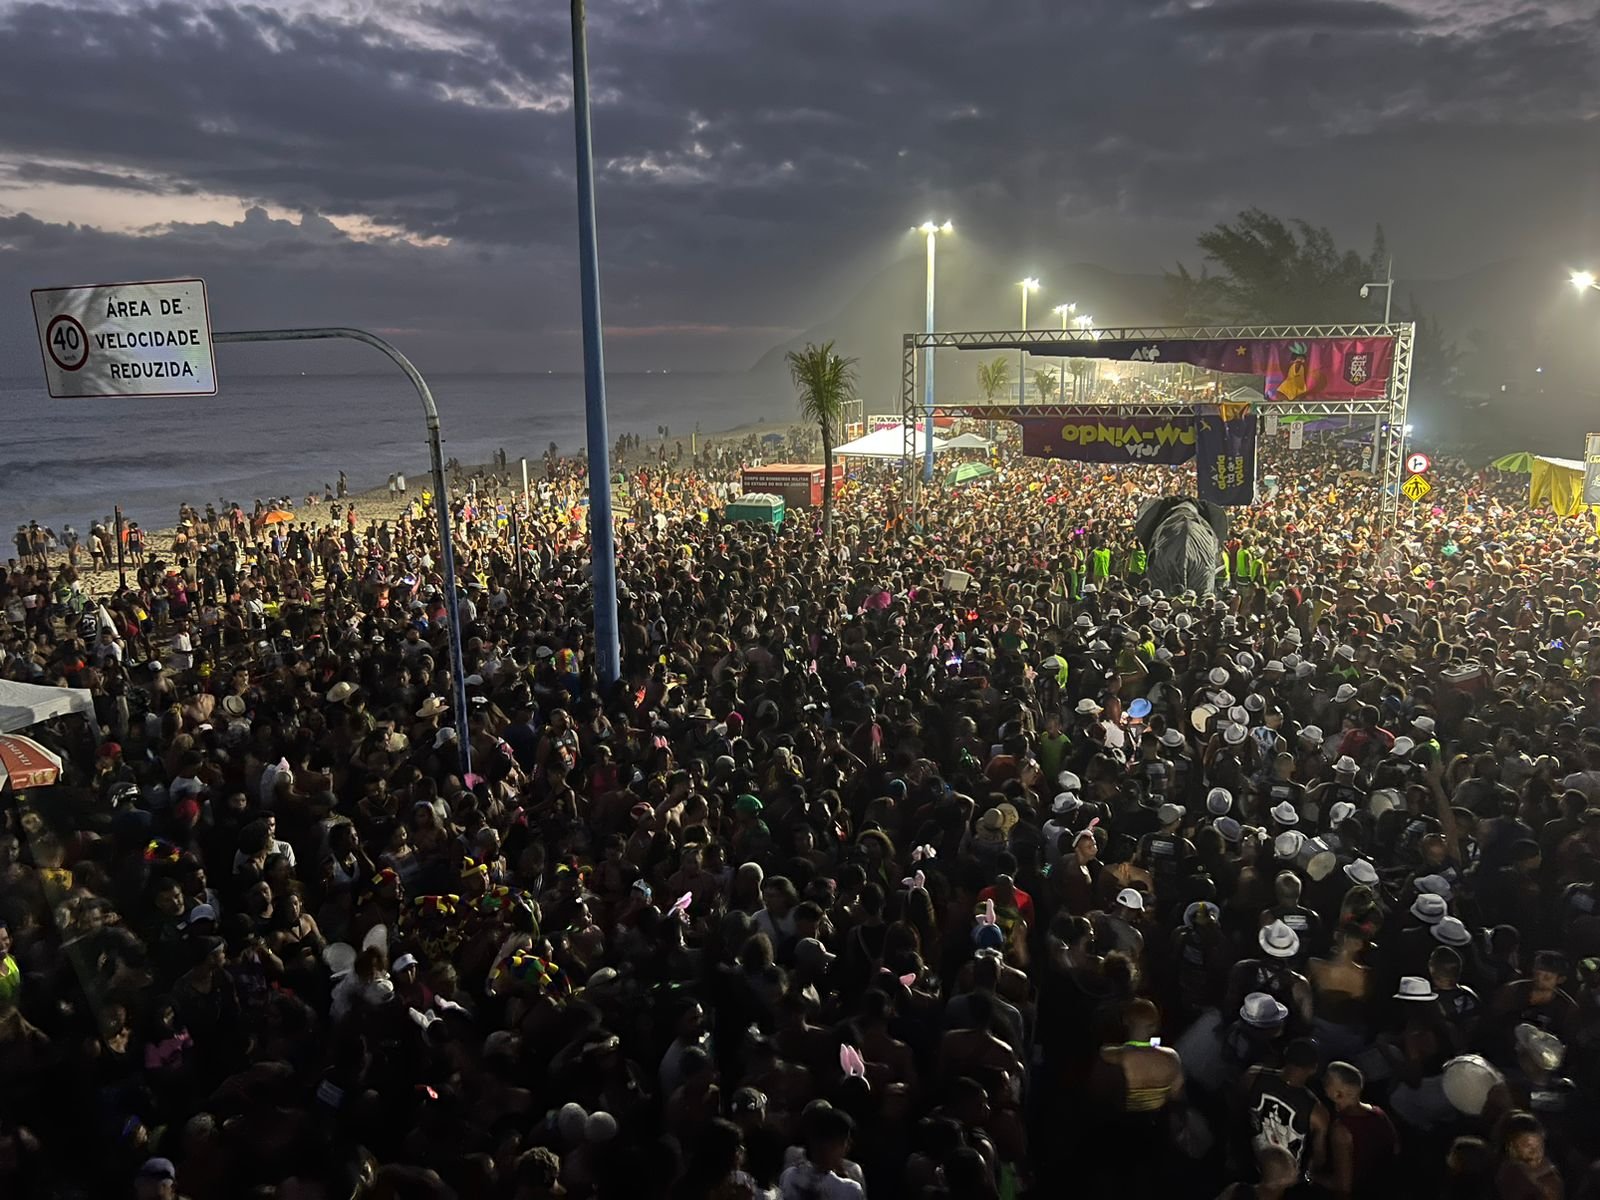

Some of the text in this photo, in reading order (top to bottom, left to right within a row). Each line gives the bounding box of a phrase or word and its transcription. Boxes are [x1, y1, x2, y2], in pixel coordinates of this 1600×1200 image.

[106, 296, 183, 318] ÁREA DE
[53, 326, 79, 351] 40
[95, 329, 200, 350] VELOCIDADE
[110, 360, 194, 379] REDUZIDA
